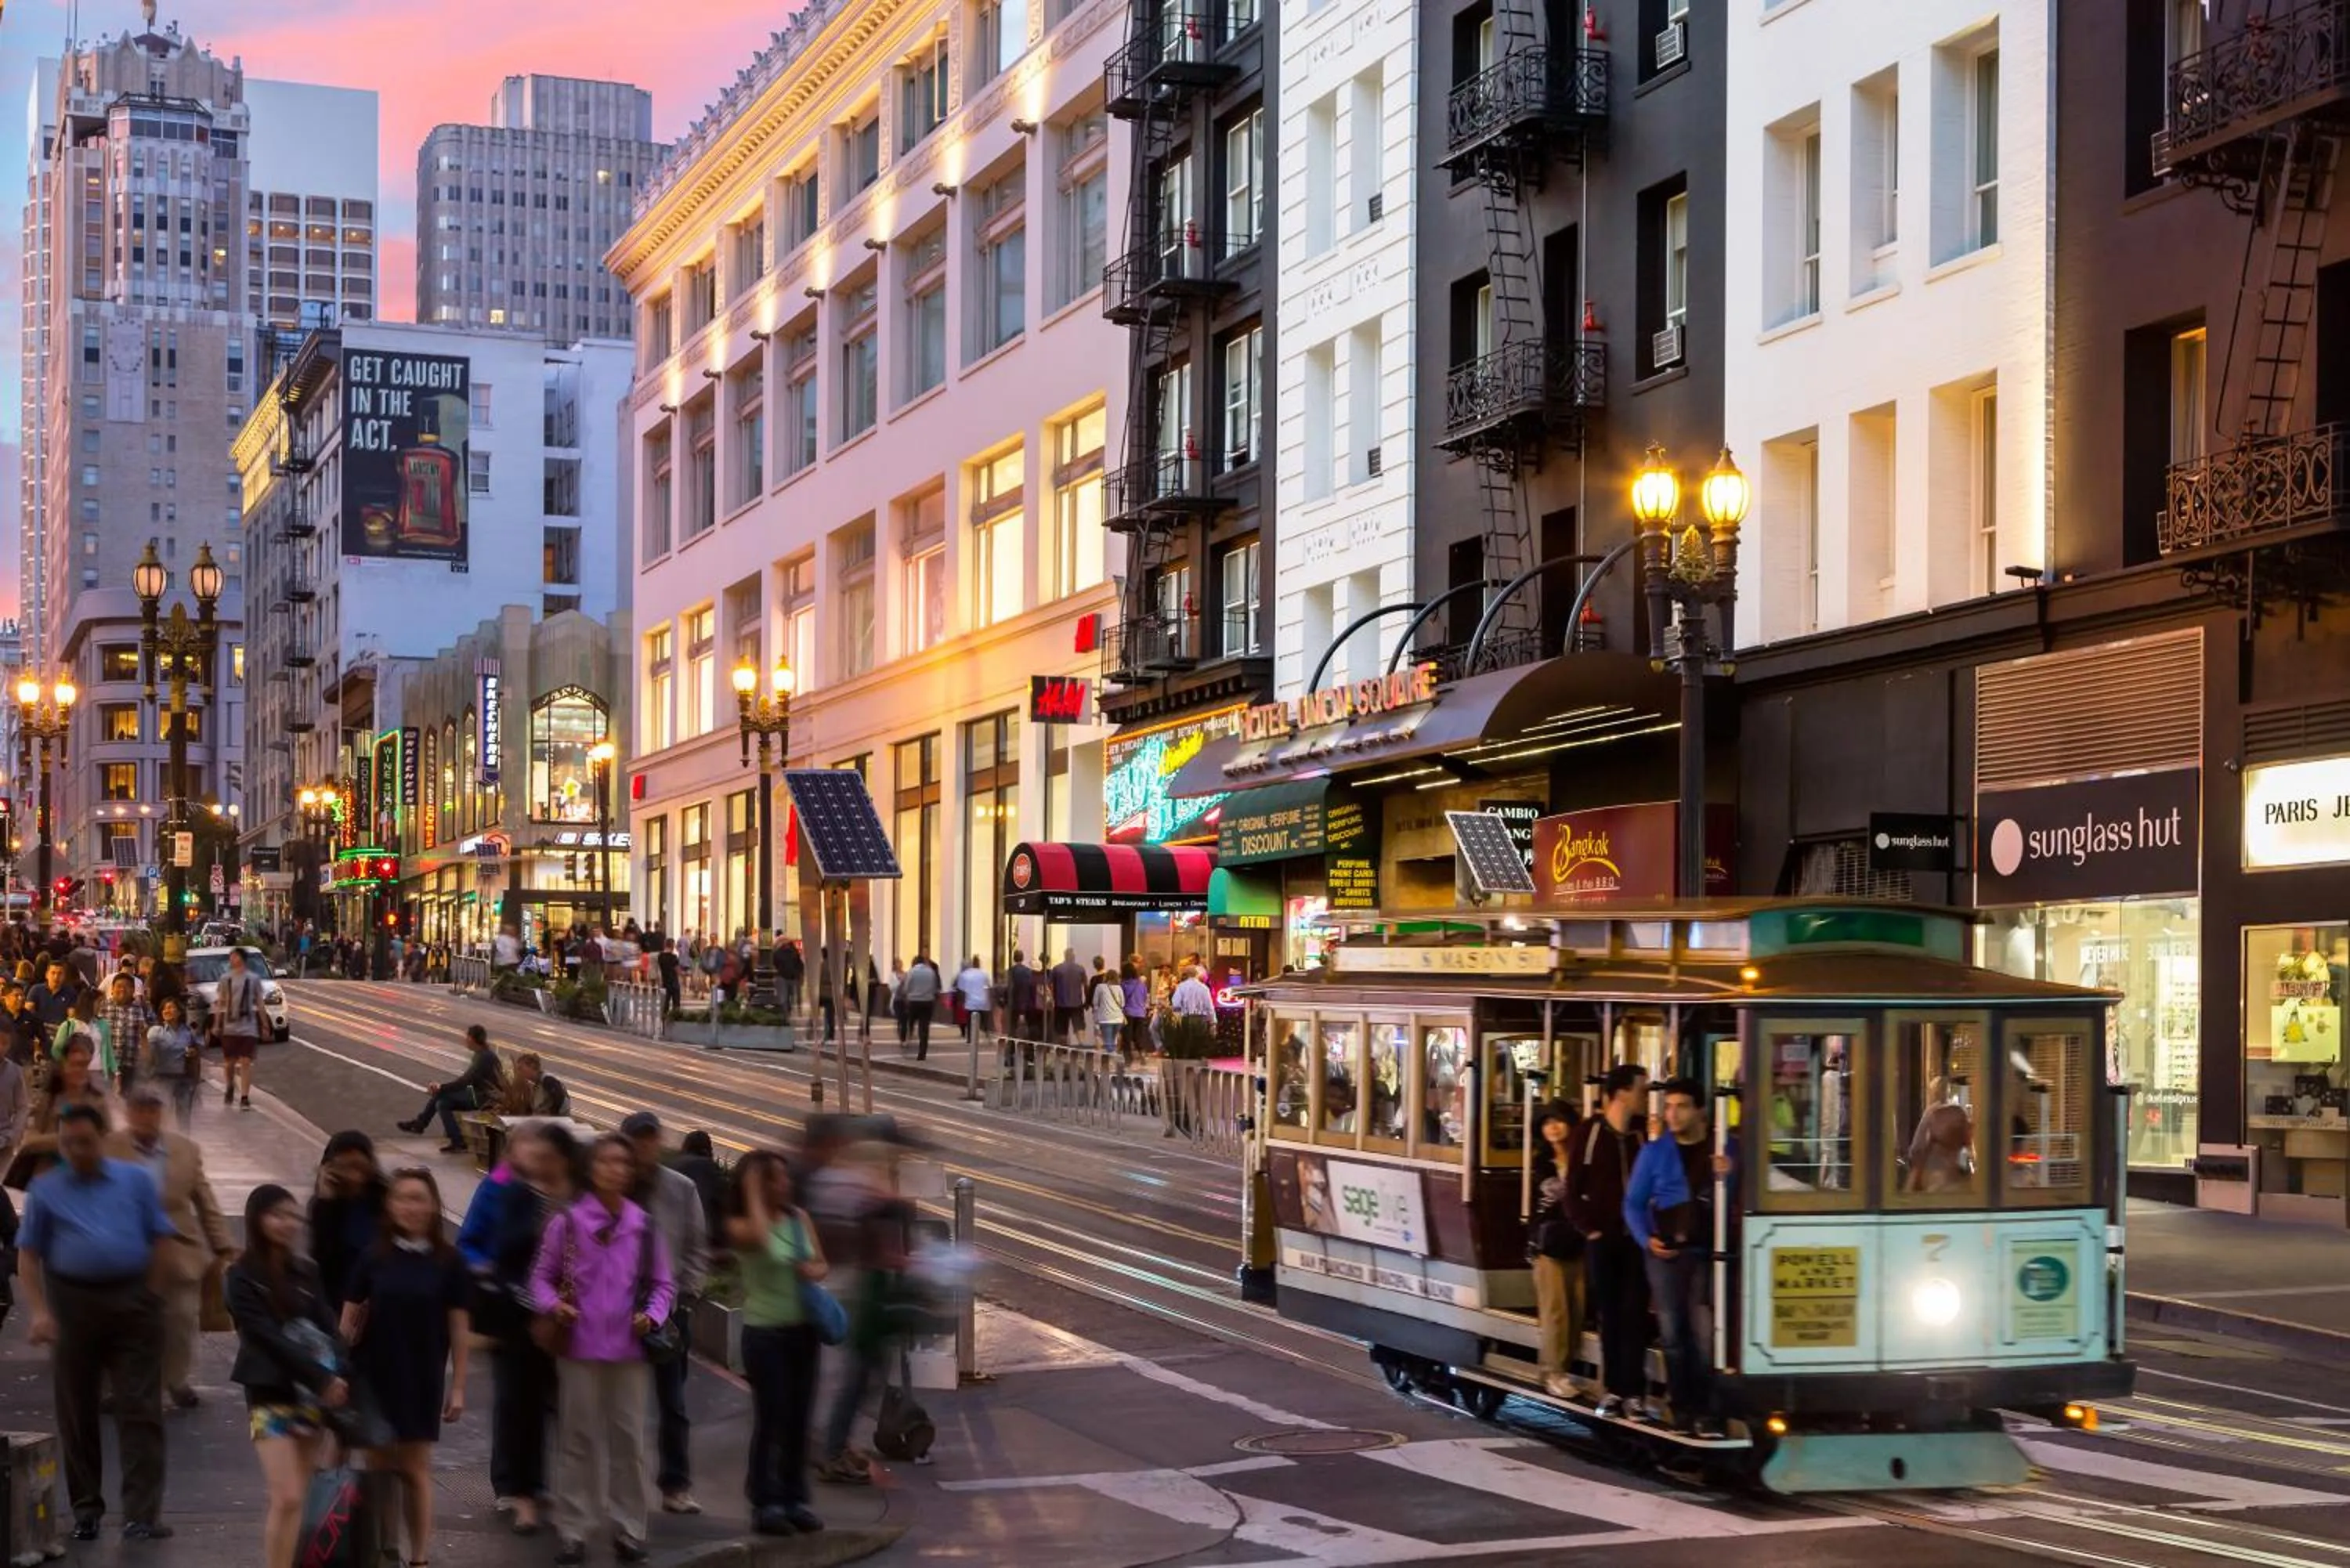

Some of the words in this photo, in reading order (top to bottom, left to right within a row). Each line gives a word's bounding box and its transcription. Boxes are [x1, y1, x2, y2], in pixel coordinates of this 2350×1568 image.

[349, 356, 384, 384] GET
[391, 359, 465, 390] CAUGHT
[351, 386, 372, 414] IN
[378, 388, 412, 417] THE
[349, 418, 397, 452] ACT.
[1240, 702, 1291, 743] HOTEL
[1297, 685, 1353, 731] UNION
[1357, 662, 1438, 716] SQUARE
[485, 677, 499, 766] SKECHERS
[2265, 797, 2319, 825] PARIS
[1242, 831, 1289, 856] DISCOUNT
[1327, 826, 1365, 843] DISCOUNT
[1553, 823, 1611, 871] Bangkok
[1891, 834, 1932, 850] sunglass
[1932, 834, 1949, 847] hut
[2029, 812, 2133, 866] sunglass
[2138, 806, 2182, 848] hut
[1048, 896, 1072, 905] TAD'S
[1076, 898, 1107, 907] STEAKS
[1239, 916, 1270, 928] ATM
[1342, 1184, 1379, 1227] sage
[1777, 1254, 1856, 1266] POWELL
[1799, 1266, 1836, 1276] AND
[1775, 1276, 1856, 1289] MARKET
